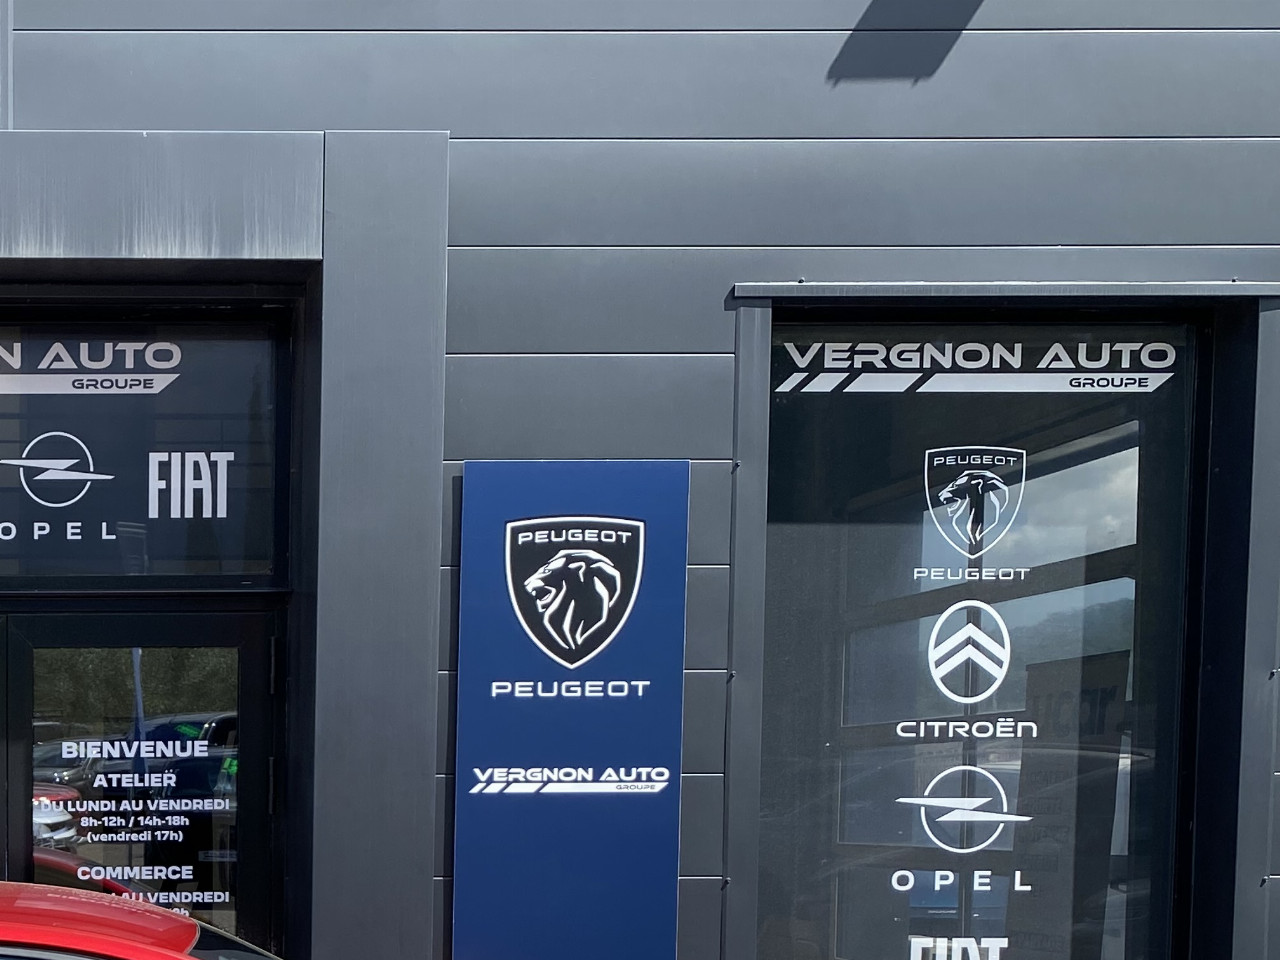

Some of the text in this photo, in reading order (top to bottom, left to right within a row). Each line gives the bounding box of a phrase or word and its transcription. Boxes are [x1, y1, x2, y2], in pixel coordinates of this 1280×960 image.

[37, 342, 182, 369] AUTO
[783, 342, 1176, 369] VERGNON AUTO
[71, 378, 155, 390] GROUPE
[1068, 377, 1150, 388] GROUPE
[933, 455, 1018, 467] PEUGEOT
[148, 451, 235, 519] FIAT
[518, 529, 632, 545] PEUGEOT
[913, 567, 1031, 580] PEUGEOT
[491, 680, 651, 698] PEUGEOT
[61, 741, 209, 758] BIENVENUE
[93, 773, 177, 788] ATELIER
[472, 767, 670, 782] VERGNON AUTO
[40, 799, 230, 812] DU LUNDI AU VENDREDI
[80, 815, 190, 828] 8h-12h / 14h-18h
[86, 830, 184, 843] (vendredi 17h)
[76, 865, 194, 880] COMMERCE
[891, 869, 1033, 892] OPEL
[147, 891, 230, 903] VENDREDI
